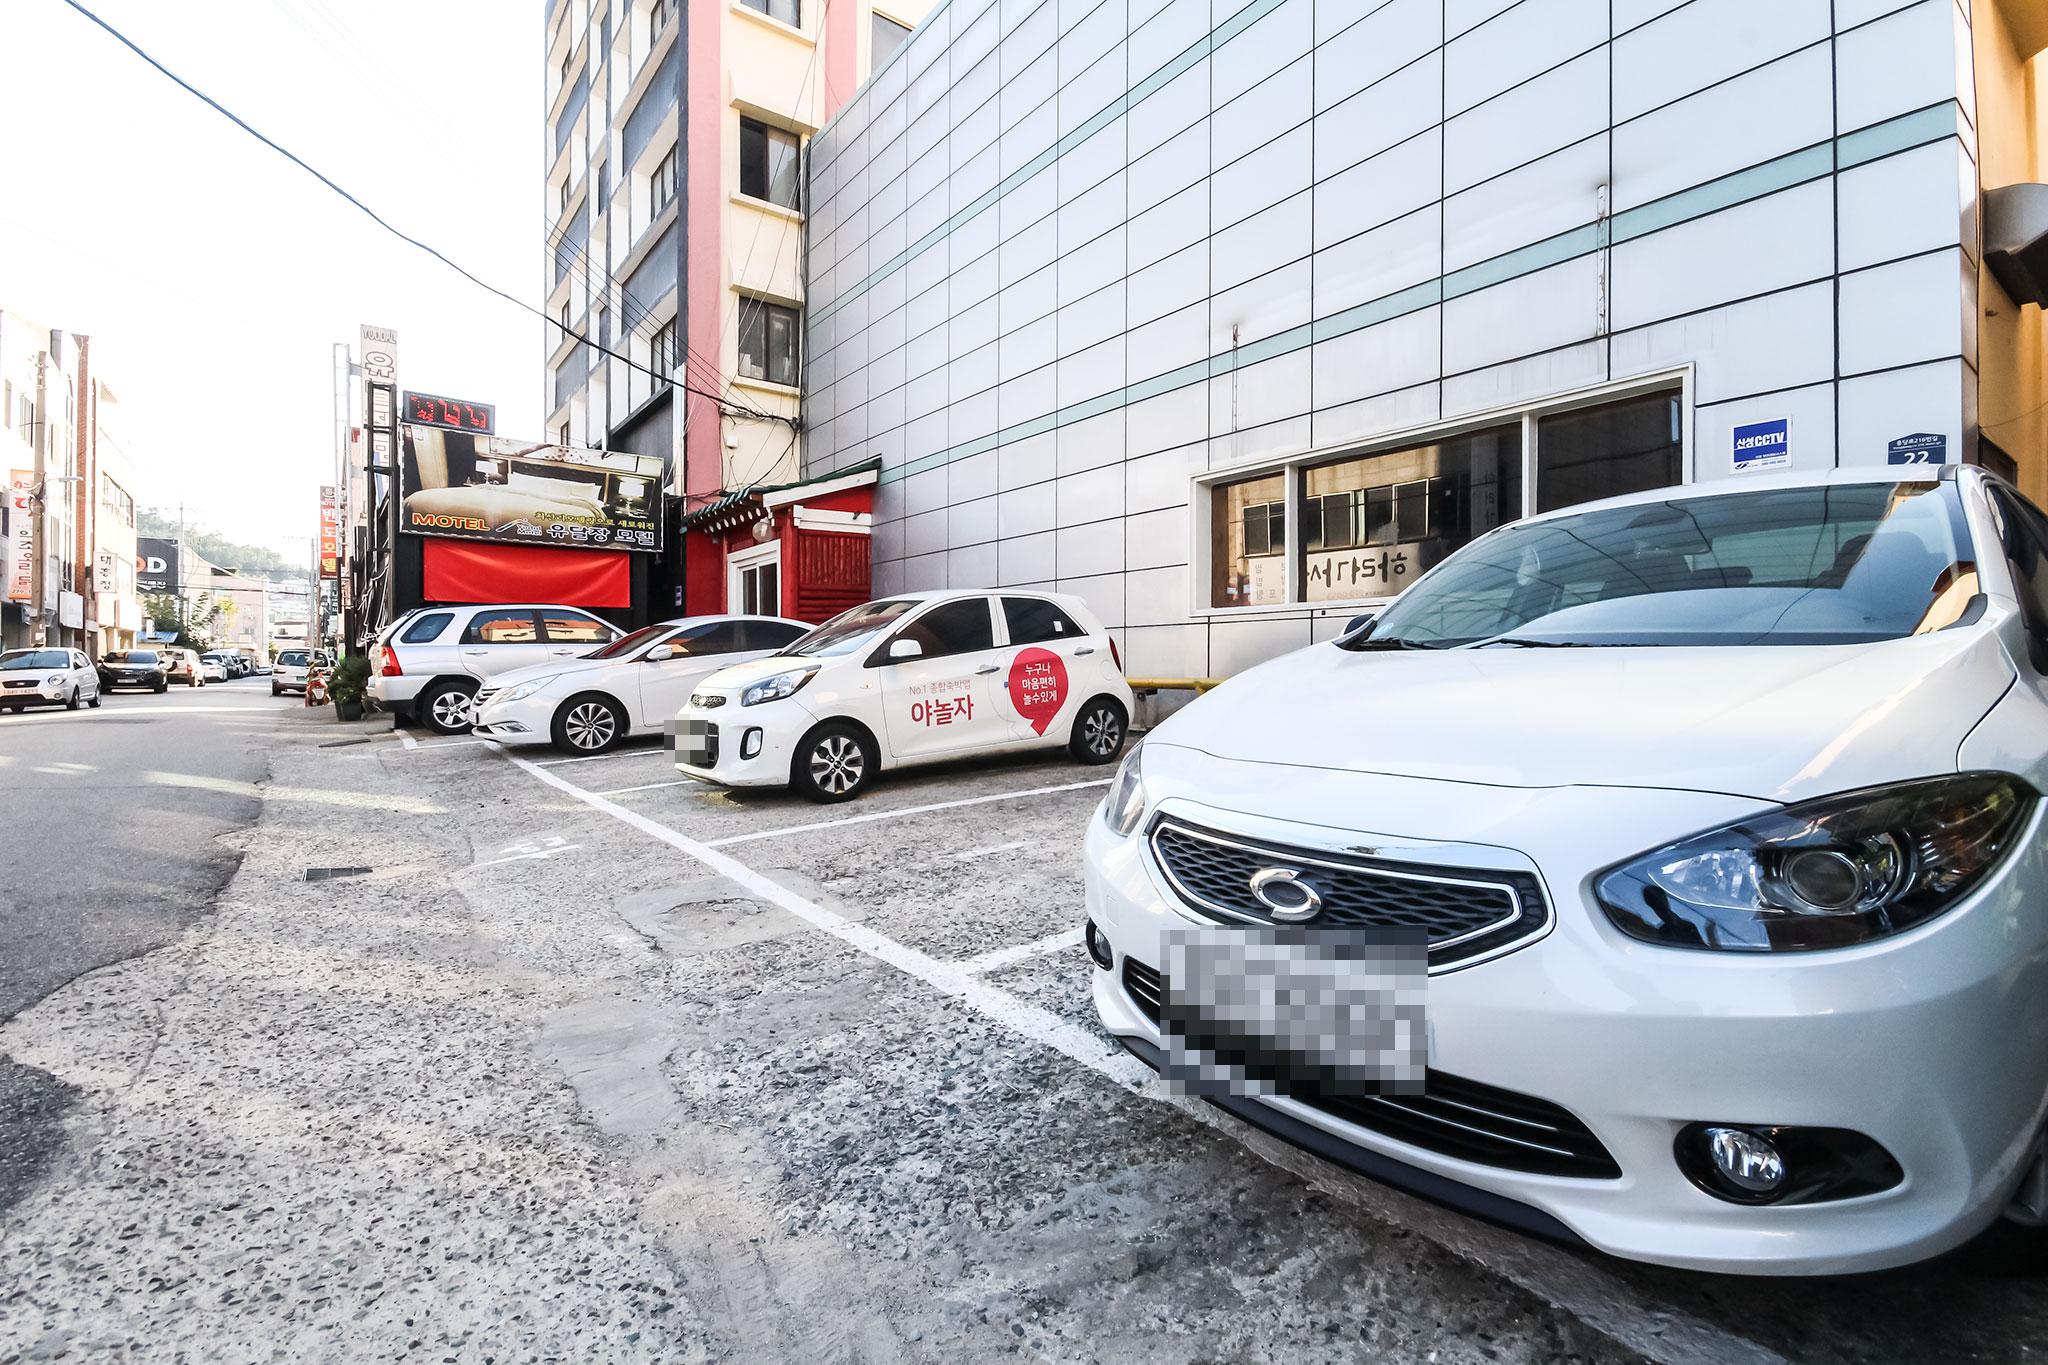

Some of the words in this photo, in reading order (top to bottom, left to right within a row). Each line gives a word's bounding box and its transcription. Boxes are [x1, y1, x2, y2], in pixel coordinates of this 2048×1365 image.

[1904, 451, 1929, 465] 22
[411, 513, 490, 532] MOTEL
[547, 524, 610, 542] 유달장
[615, 529, 655, 546] 모텔
[1025, 662, 1051, 676] 누구나
[929, 679, 971, 694] 종합숙박앱
[1022, 676, 1056, 690] 마음편히
[911, 694, 974, 727] 야놀자
